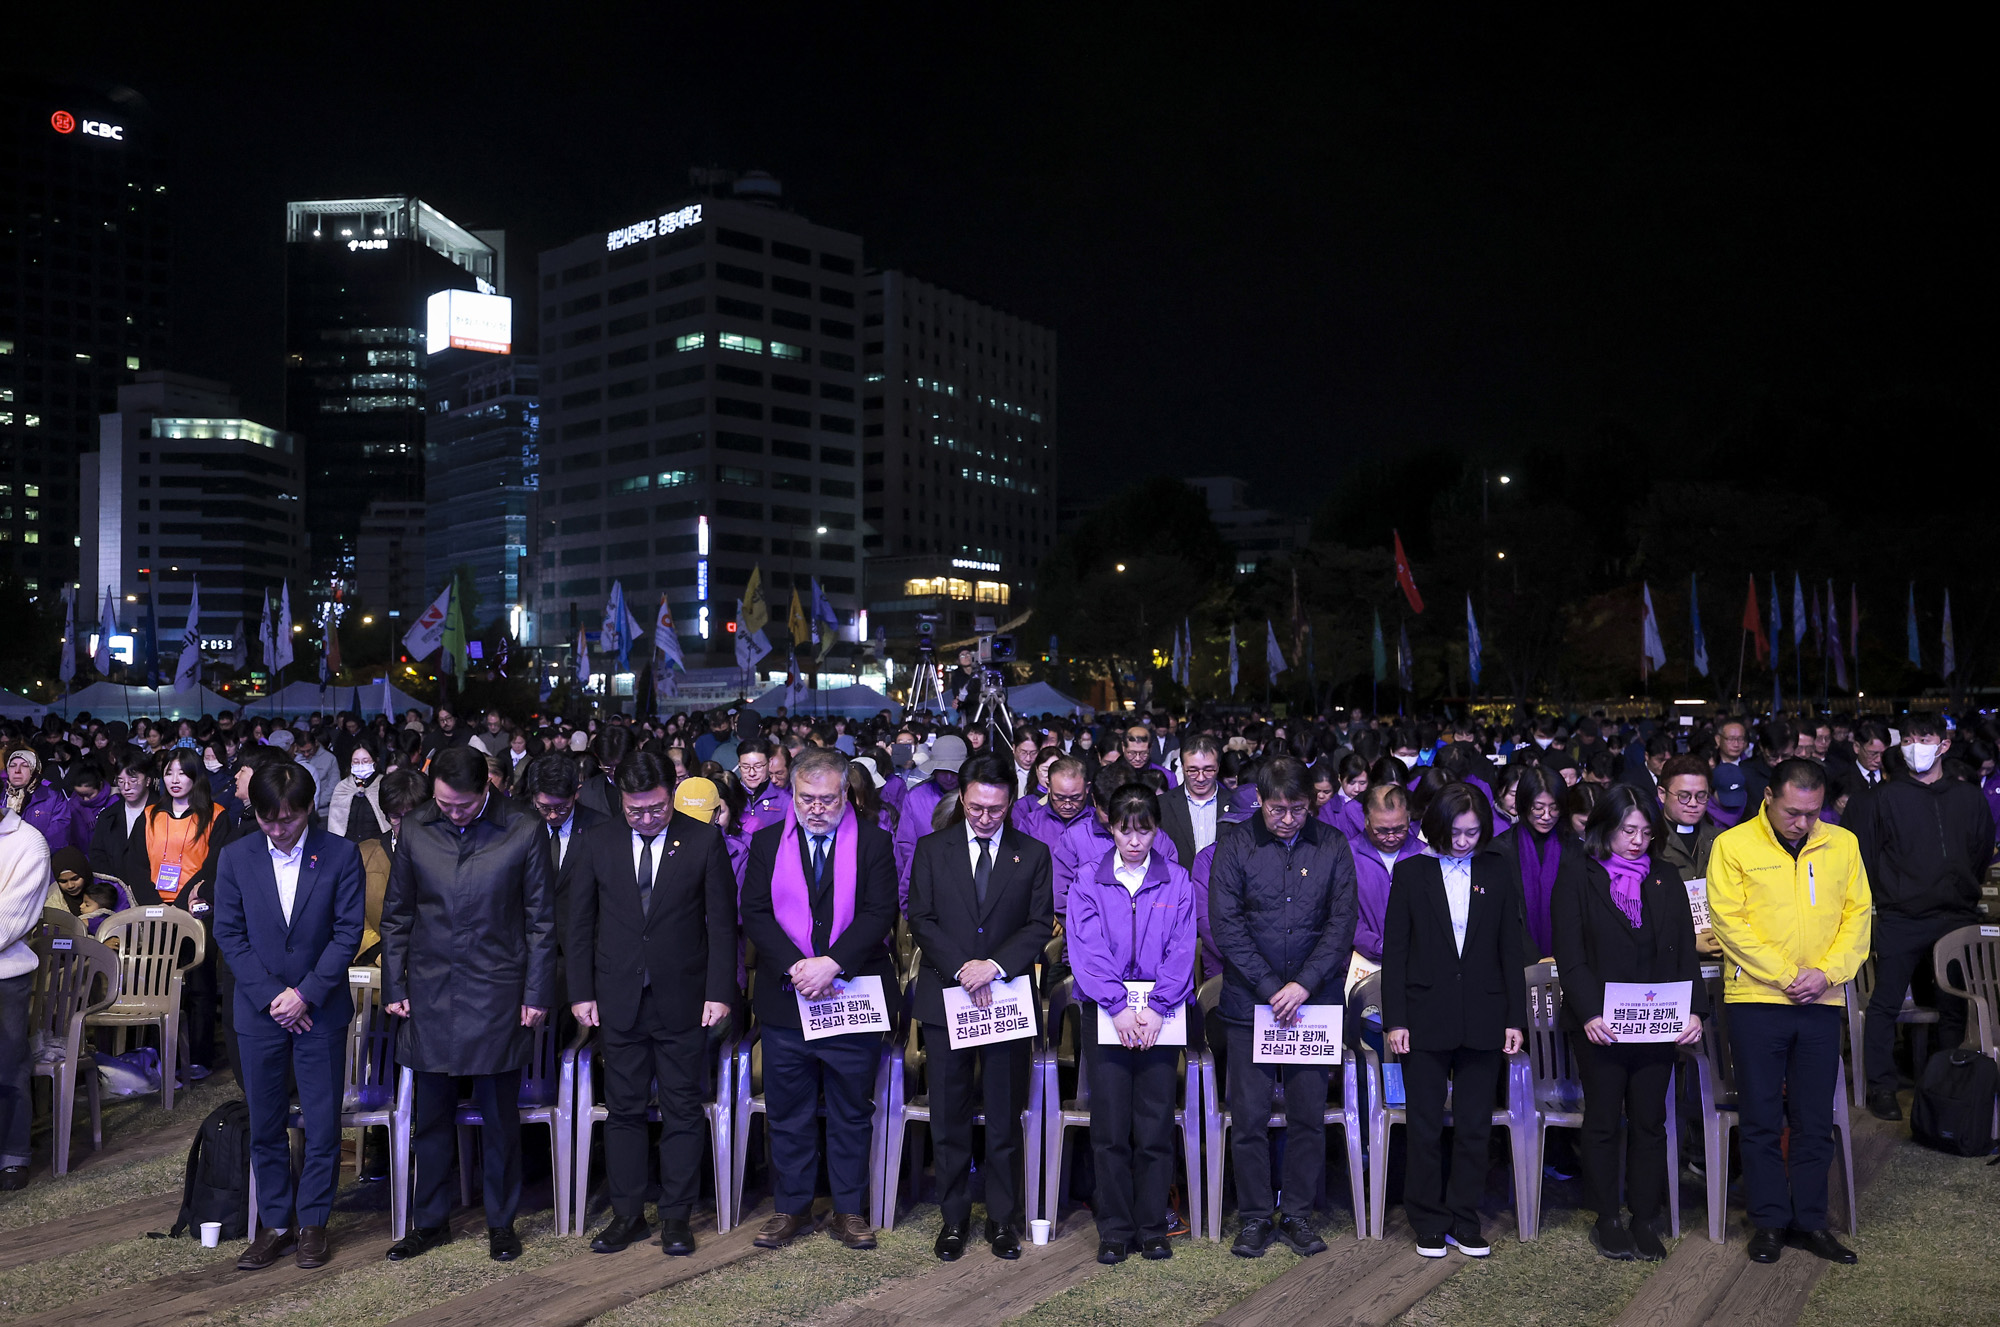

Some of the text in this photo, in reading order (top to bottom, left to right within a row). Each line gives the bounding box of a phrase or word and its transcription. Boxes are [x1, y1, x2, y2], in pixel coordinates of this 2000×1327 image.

[82, 119, 123, 140] ICBC
[607, 204, 702, 251] 취업사관학교 경동대학교
[809, 1000, 874, 1017] 별들과 함께,
[956, 1003, 1022, 1025] 별들과 함께,
[1614, 1008, 1679, 1021] 별들과 함께,
[809, 1012, 882, 1031] 진실과 정의로
[956, 1017, 1029, 1040] 진실과 정의로
[1610, 1021, 1683, 1034] 진실과 정의로
[1264, 1030, 1329, 1043] 별들과 함께,
[1261, 1044, 1335, 1056] 진실과 정의로
